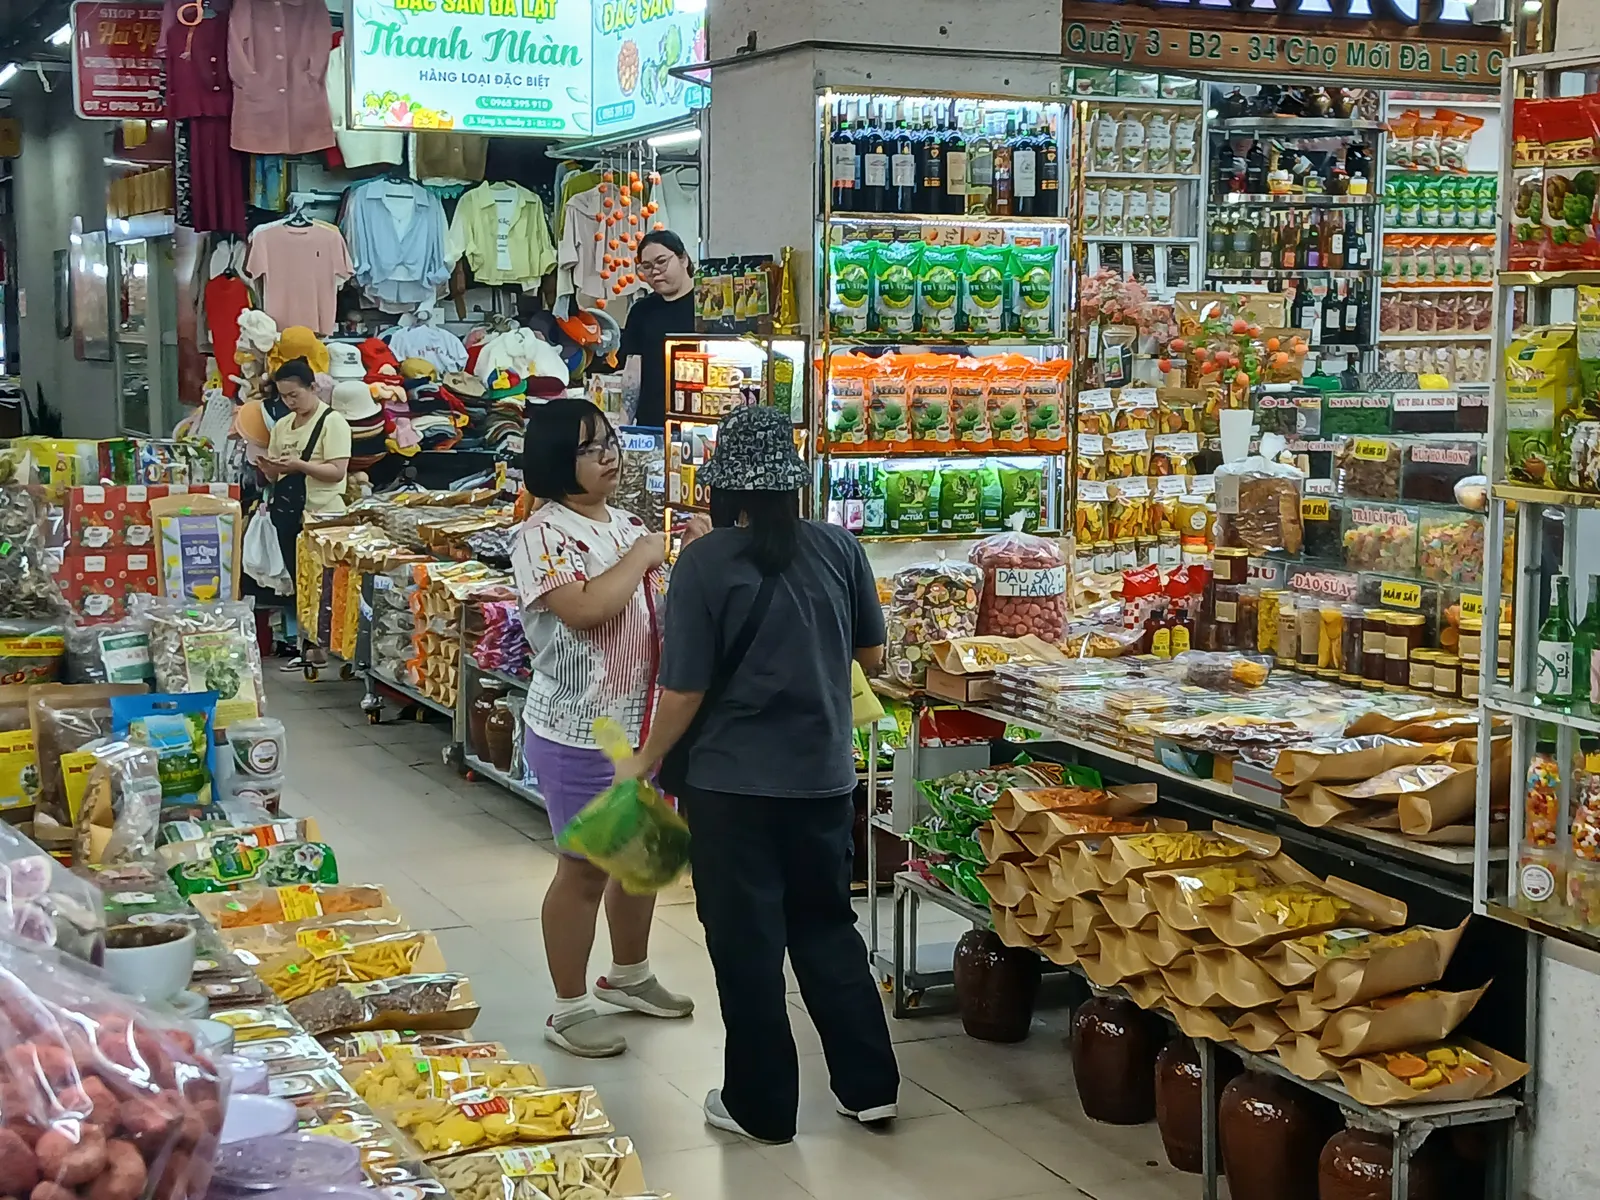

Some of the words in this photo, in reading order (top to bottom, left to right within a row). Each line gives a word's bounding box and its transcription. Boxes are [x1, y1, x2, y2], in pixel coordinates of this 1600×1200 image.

[99, 8, 136, 19] SHOP
[363, 20, 473, 61] Thanh
[484, 28, 583, 67] Nhàn
[1145, 29, 1162, 57] 3
[1187, 31, 1223, 60] B2
[1247, 34, 1278, 63] 34
[1284, 36, 1339, 71] Chợ
[1346, 40, 1390, 69] Mới
[1399, 43, 1431, 71] Đà
[1441, 46, 1479, 79] Lạt
[419, 68, 458, 83] HÀNG
[461, 72, 491, 87] LOẠI
[494, 72, 522, 88] ĐẶC
[526, 74, 551, 90] BIỆT
[998, 568, 1028, 583] DÂU
